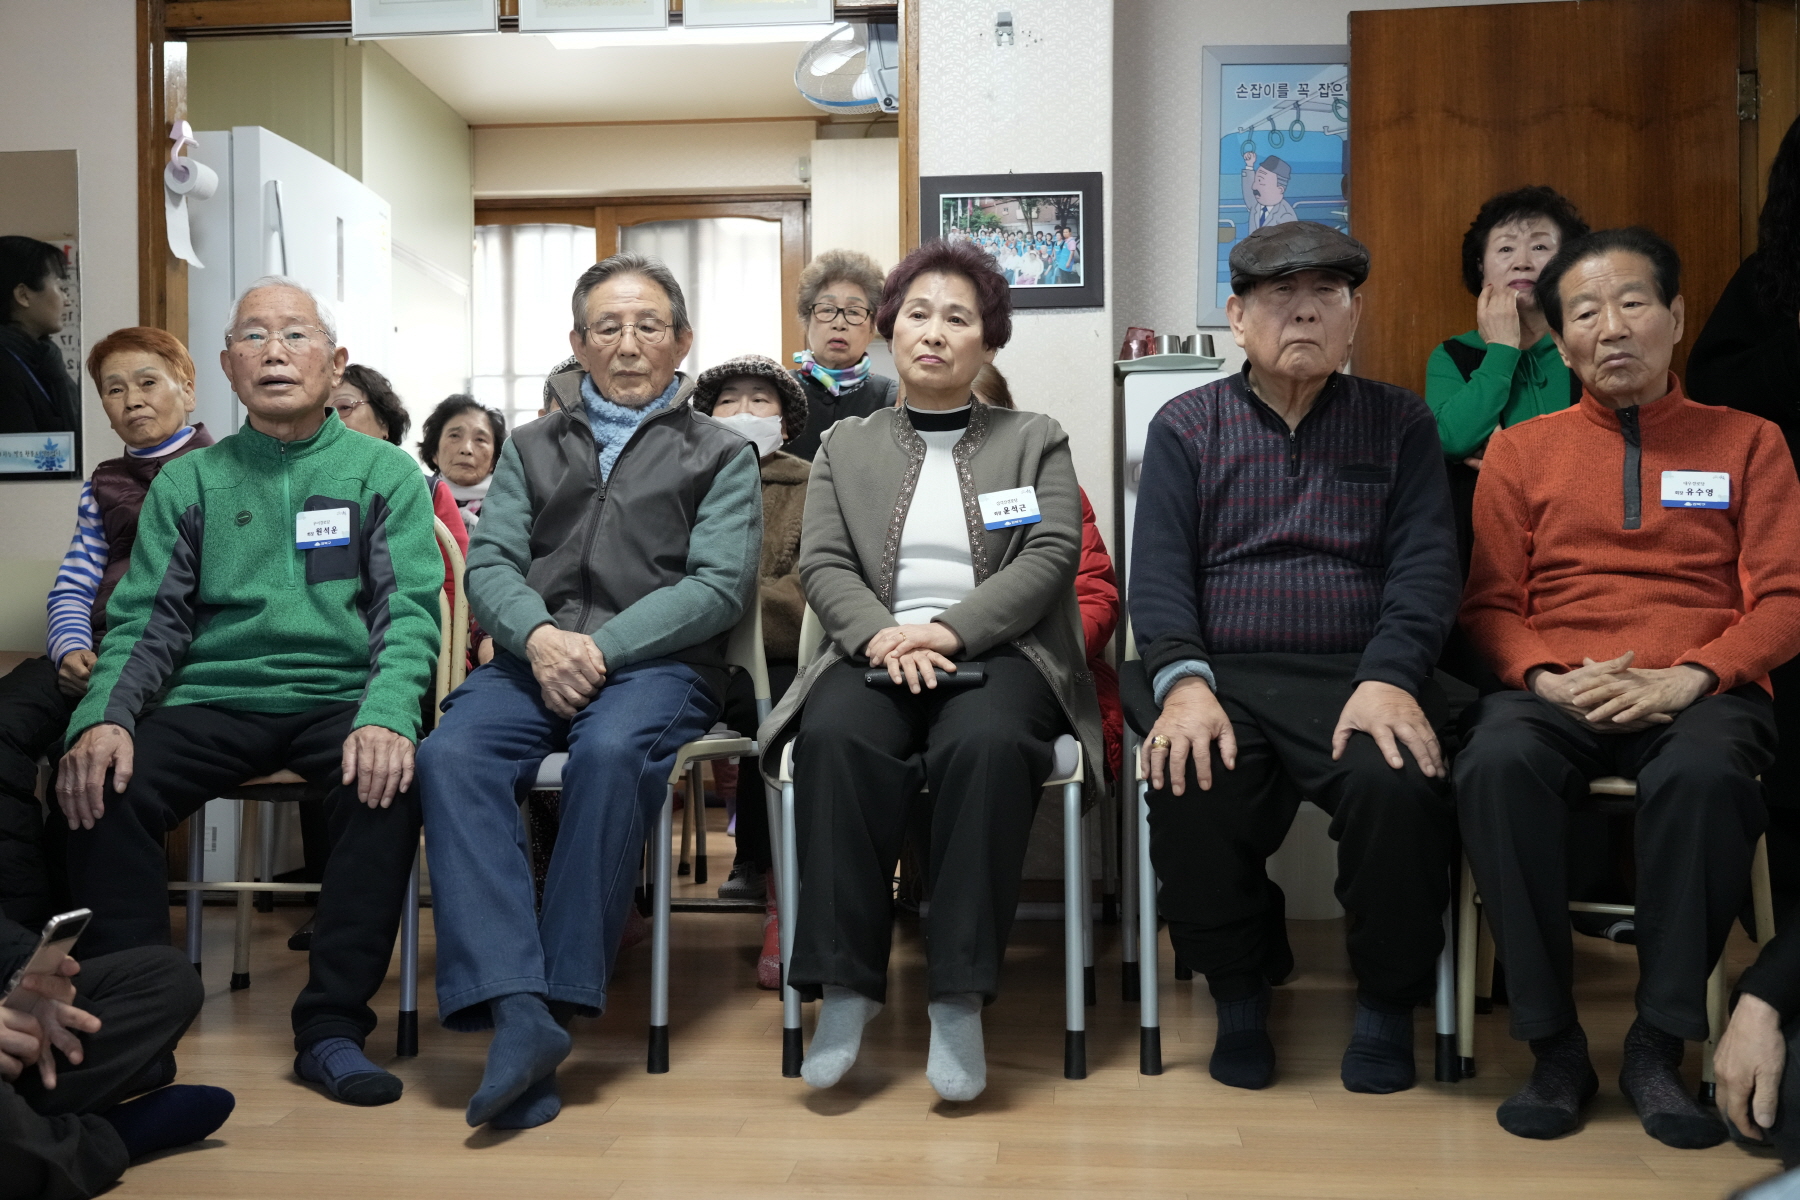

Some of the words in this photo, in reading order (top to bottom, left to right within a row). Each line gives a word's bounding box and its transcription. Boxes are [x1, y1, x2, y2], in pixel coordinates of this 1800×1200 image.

[1236, 83, 1289, 98] 손잡이를
[1297, 83, 1310, 98] 꼭
[1318, 82, 1348, 98] 잡으
[1685, 487, 1714, 497] 유수영
